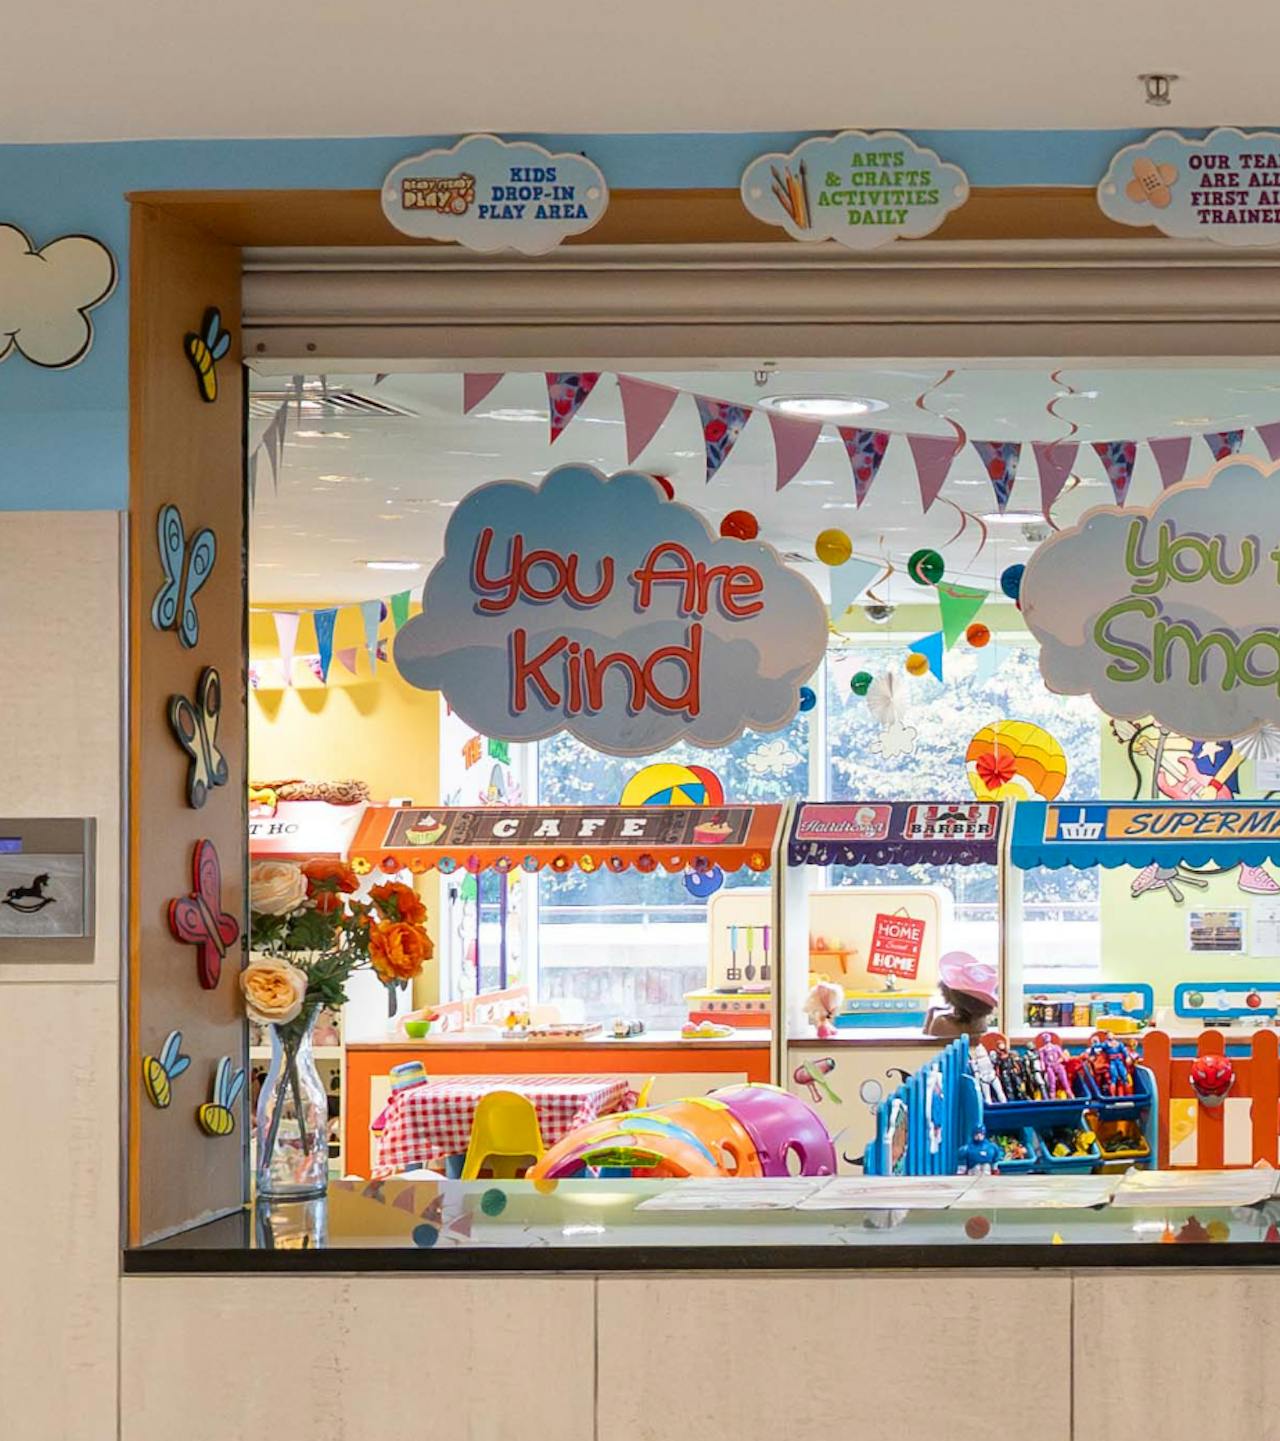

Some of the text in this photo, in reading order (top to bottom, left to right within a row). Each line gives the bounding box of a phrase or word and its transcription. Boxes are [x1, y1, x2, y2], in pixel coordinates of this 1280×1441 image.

[851, 152, 904, 167] ARTS
[1188, 154, 1230, 170] OUR
[510, 167, 557, 183] KIDS
[825, 170, 931, 187] & CRAFTS
[1199, 173, 1239, 187] ARE
[403, 191, 451, 207] PLAY
[491, 186, 575, 202] DROP-IN
[818, 189, 939, 206] ACTIVITIES
[1191, 191, 1249, 206] FIRST
[478, 204, 589, 219] PLAY AREA
[847, 209, 908, 225] DAILY
[1125, 520, 1254, 595] You
[474, 527, 765, 617] You Are
[511, 622, 702, 717] Kind
[492, 816, 650, 838] CAFE
[911, 823, 990, 834] BARBER
[878, 923, 921, 941] HOME
[872, 952, 916, 972] HOME
